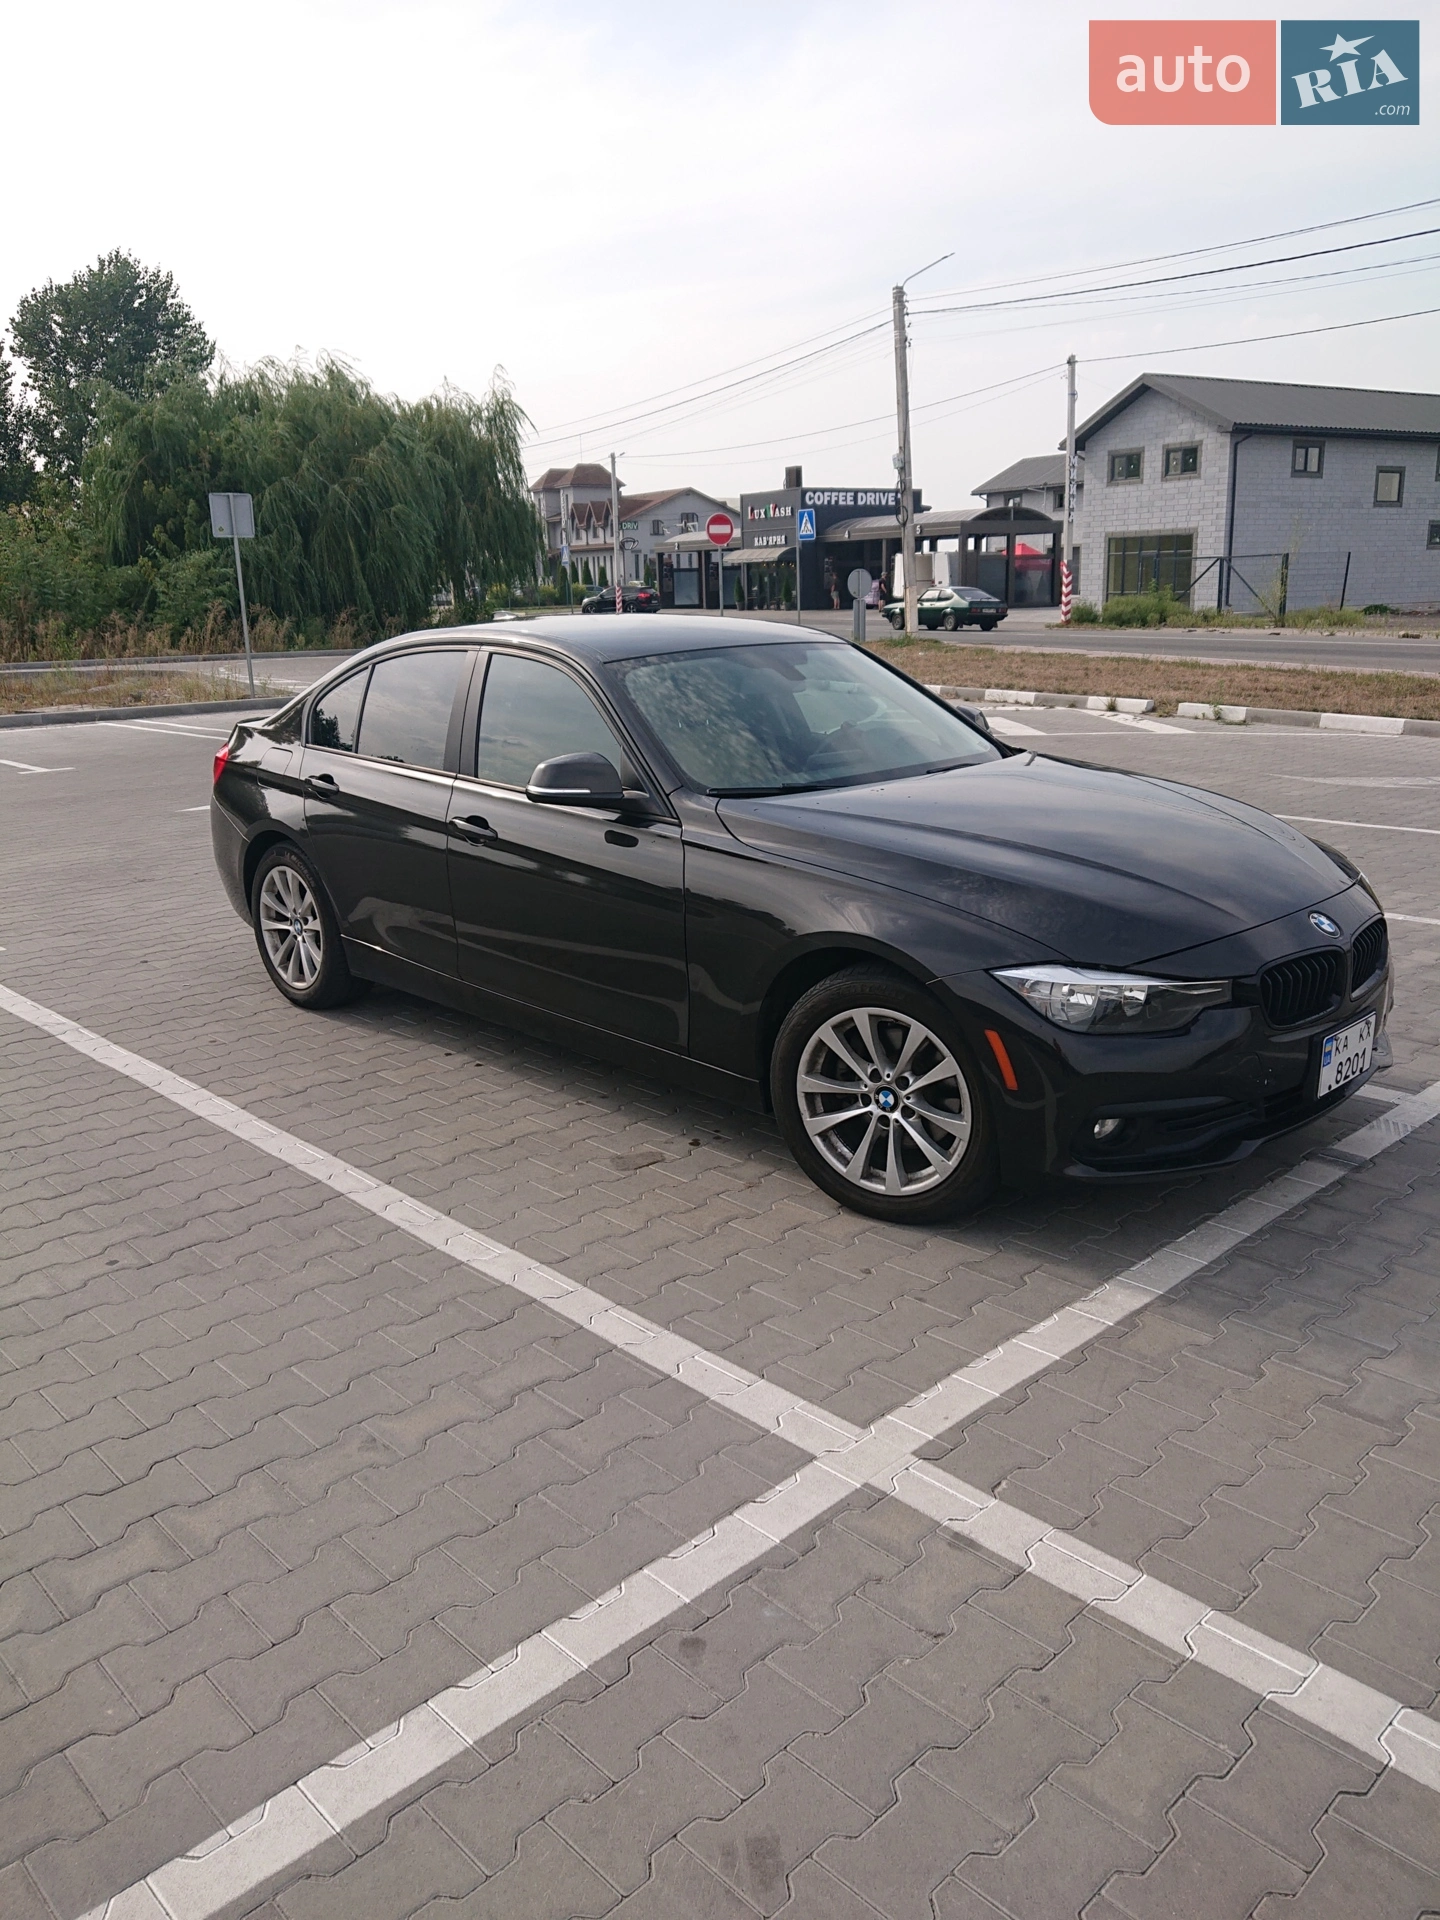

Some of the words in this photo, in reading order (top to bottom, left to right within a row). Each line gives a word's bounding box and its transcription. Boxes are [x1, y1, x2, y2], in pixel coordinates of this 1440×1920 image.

[805, 491, 854, 505] COFFEE
[857, 492, 896, 506] DRIVE
[916, 525, 921, 535] 5
[754, 535, 786, 547] КАВ'ЯРНЯ
[1334, 1035, 1349, 1057] KA
[1359, 1021, 1372, 1044] KX
[1335, 1047, 1367, 1085] 8201
